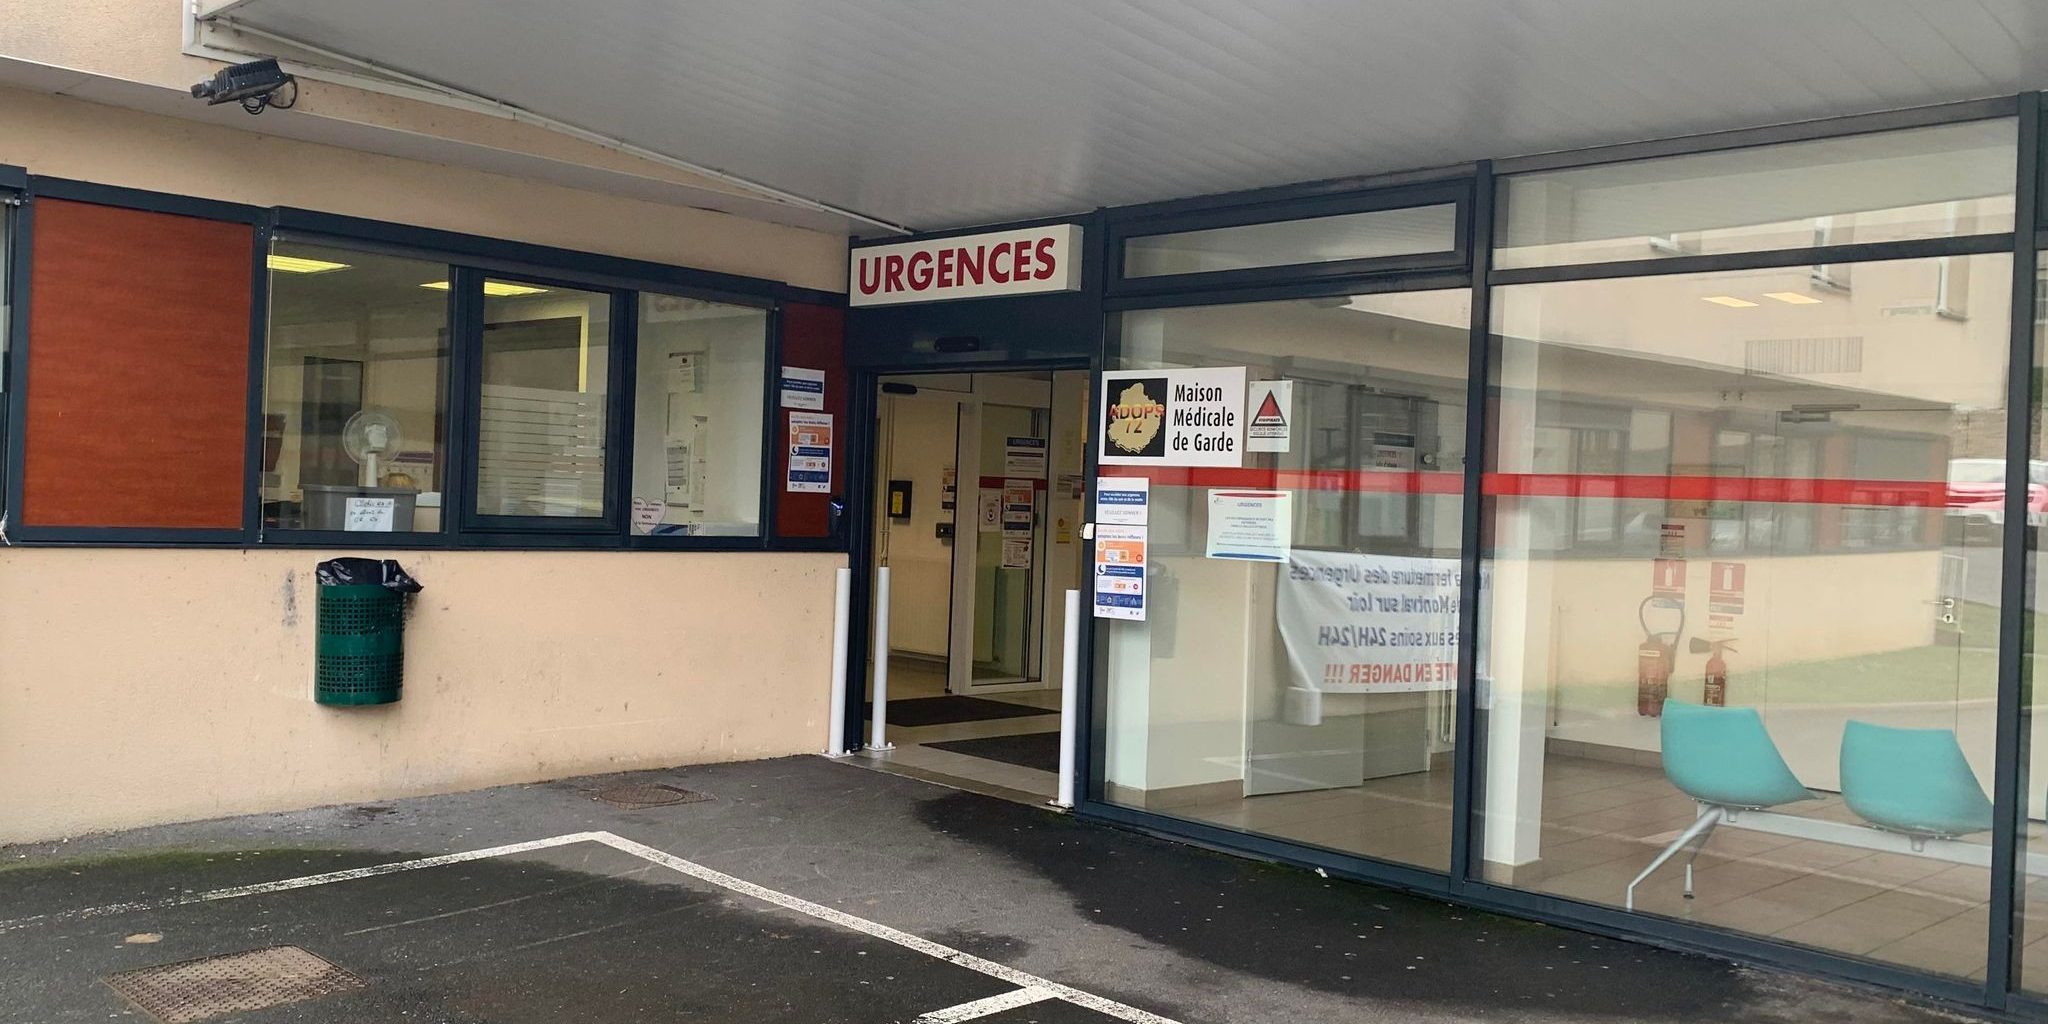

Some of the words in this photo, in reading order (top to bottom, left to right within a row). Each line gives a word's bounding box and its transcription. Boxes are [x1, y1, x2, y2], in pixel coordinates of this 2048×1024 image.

[859, 237, 1056, 295] URGENCES
[1174, 382, 1222, 402] Maison
[1109, 403, 1165, 419] ADOPS
[1173, 406, 1234, 427] Médicale
[1125, 420, 1142, 433] 72
[1172, 431, 1189, 451] de
[1194, 431, 1234, 452] Garde
